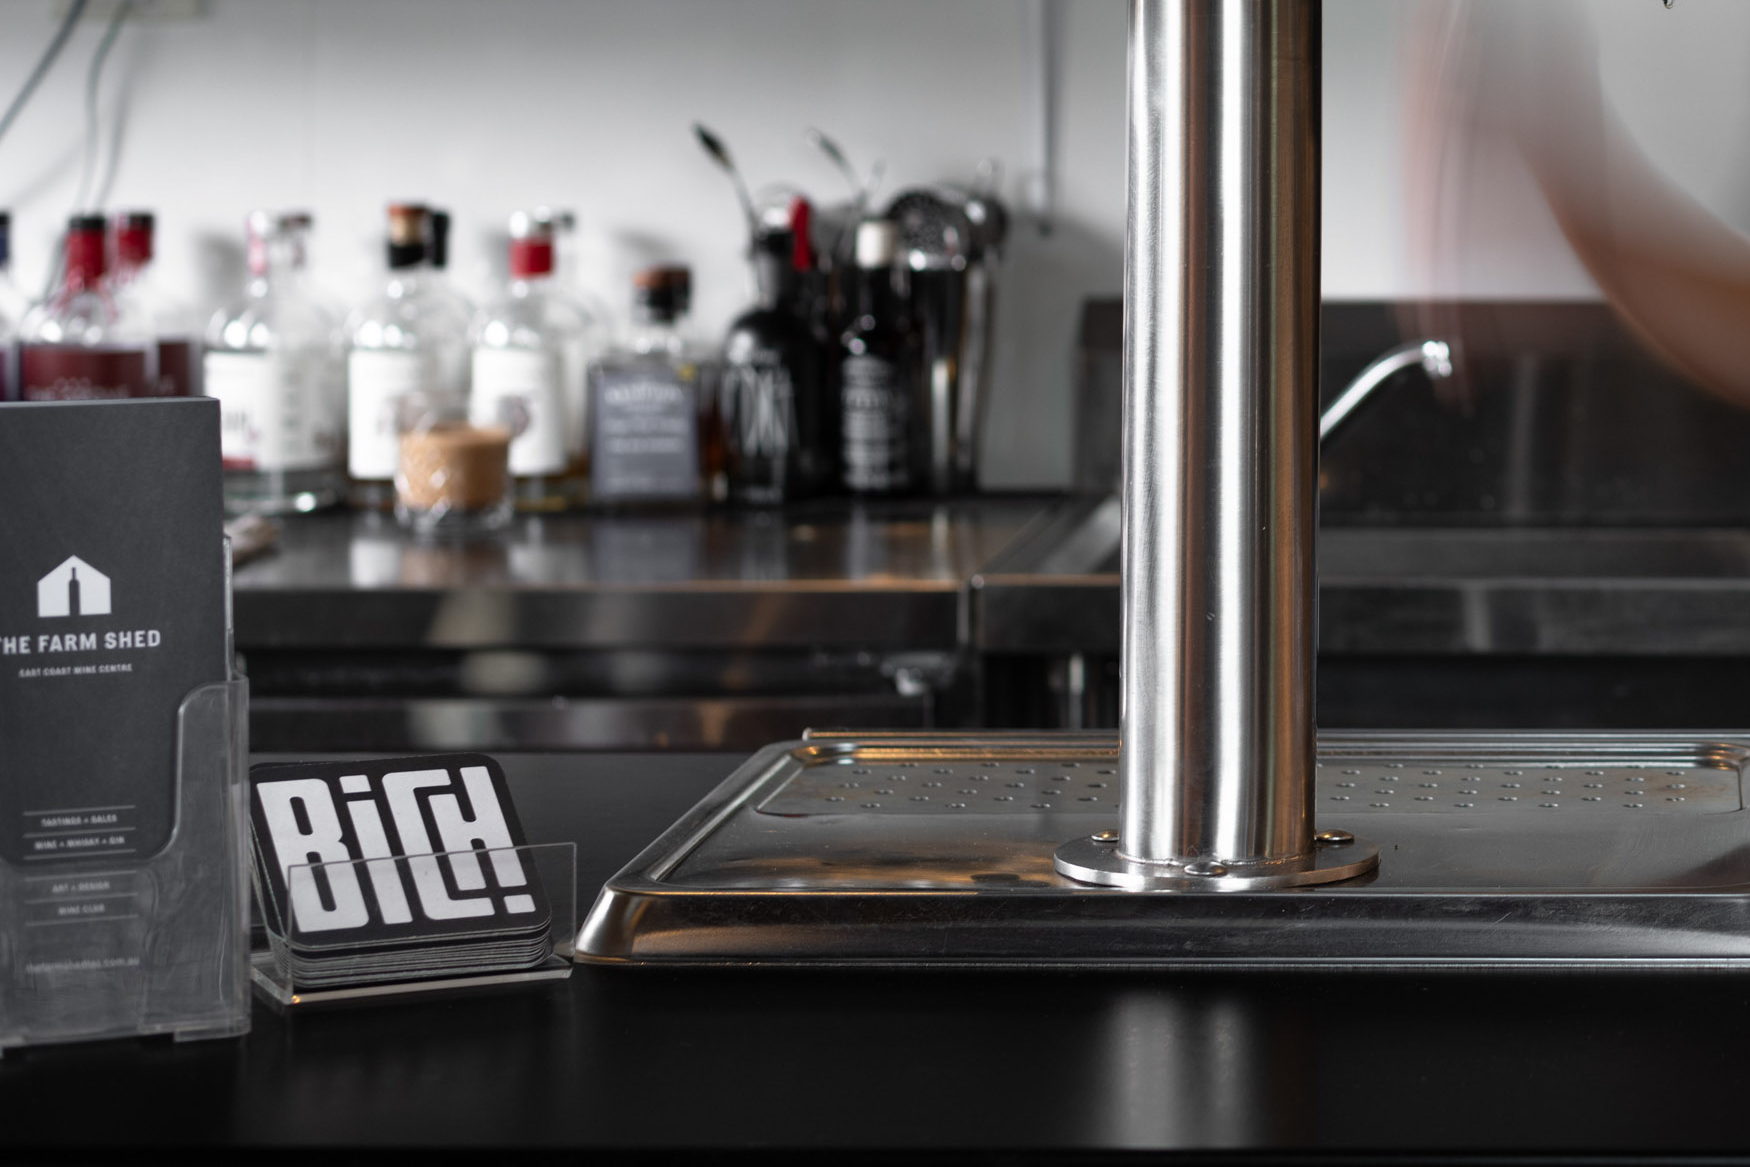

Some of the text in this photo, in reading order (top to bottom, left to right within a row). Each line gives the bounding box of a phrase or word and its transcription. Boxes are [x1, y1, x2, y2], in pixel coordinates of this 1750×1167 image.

[0, 630, 161, 654] HE FARM SHED
[99, 663, 132, 673] CENTRE
